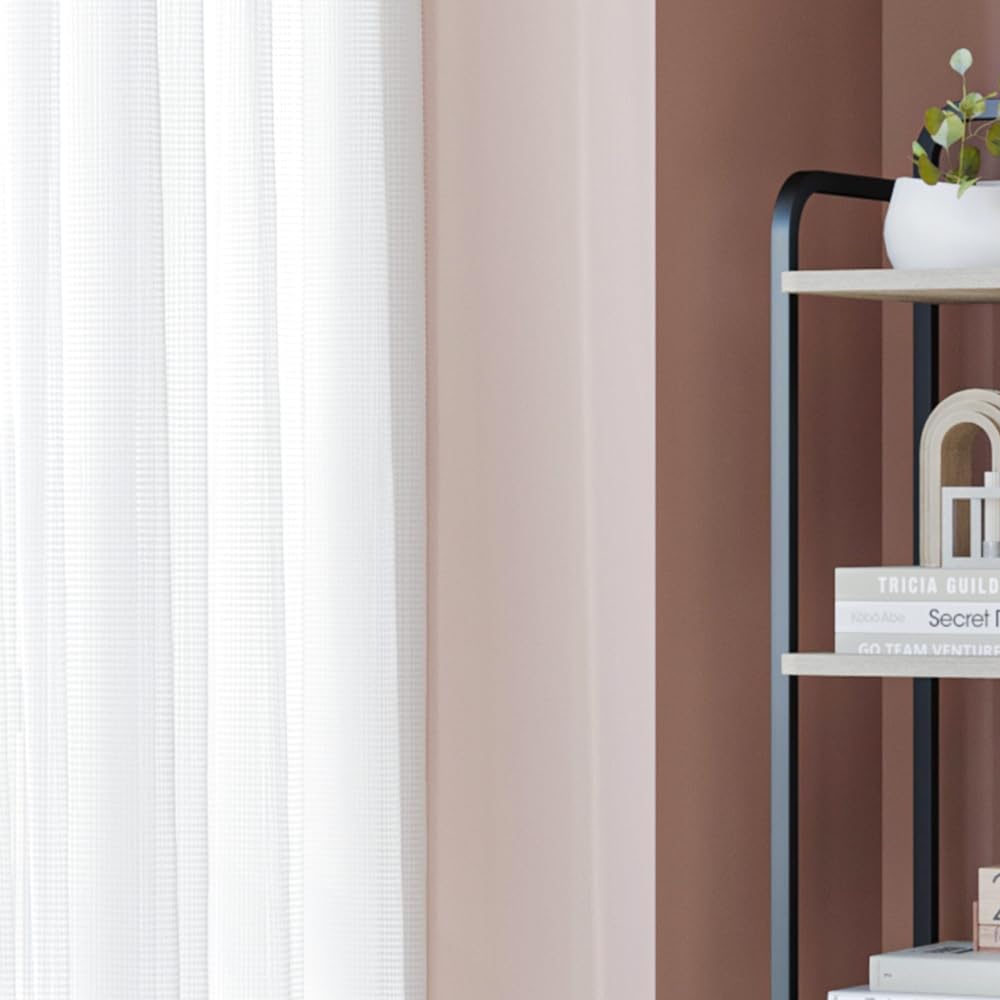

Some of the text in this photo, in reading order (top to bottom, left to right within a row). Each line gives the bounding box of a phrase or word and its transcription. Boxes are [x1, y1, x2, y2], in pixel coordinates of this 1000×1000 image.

[877, 576, 938, 594] TRICIA
[946, 576, 999, 595] GUILD
[929, 608, 989, 628] Secret
